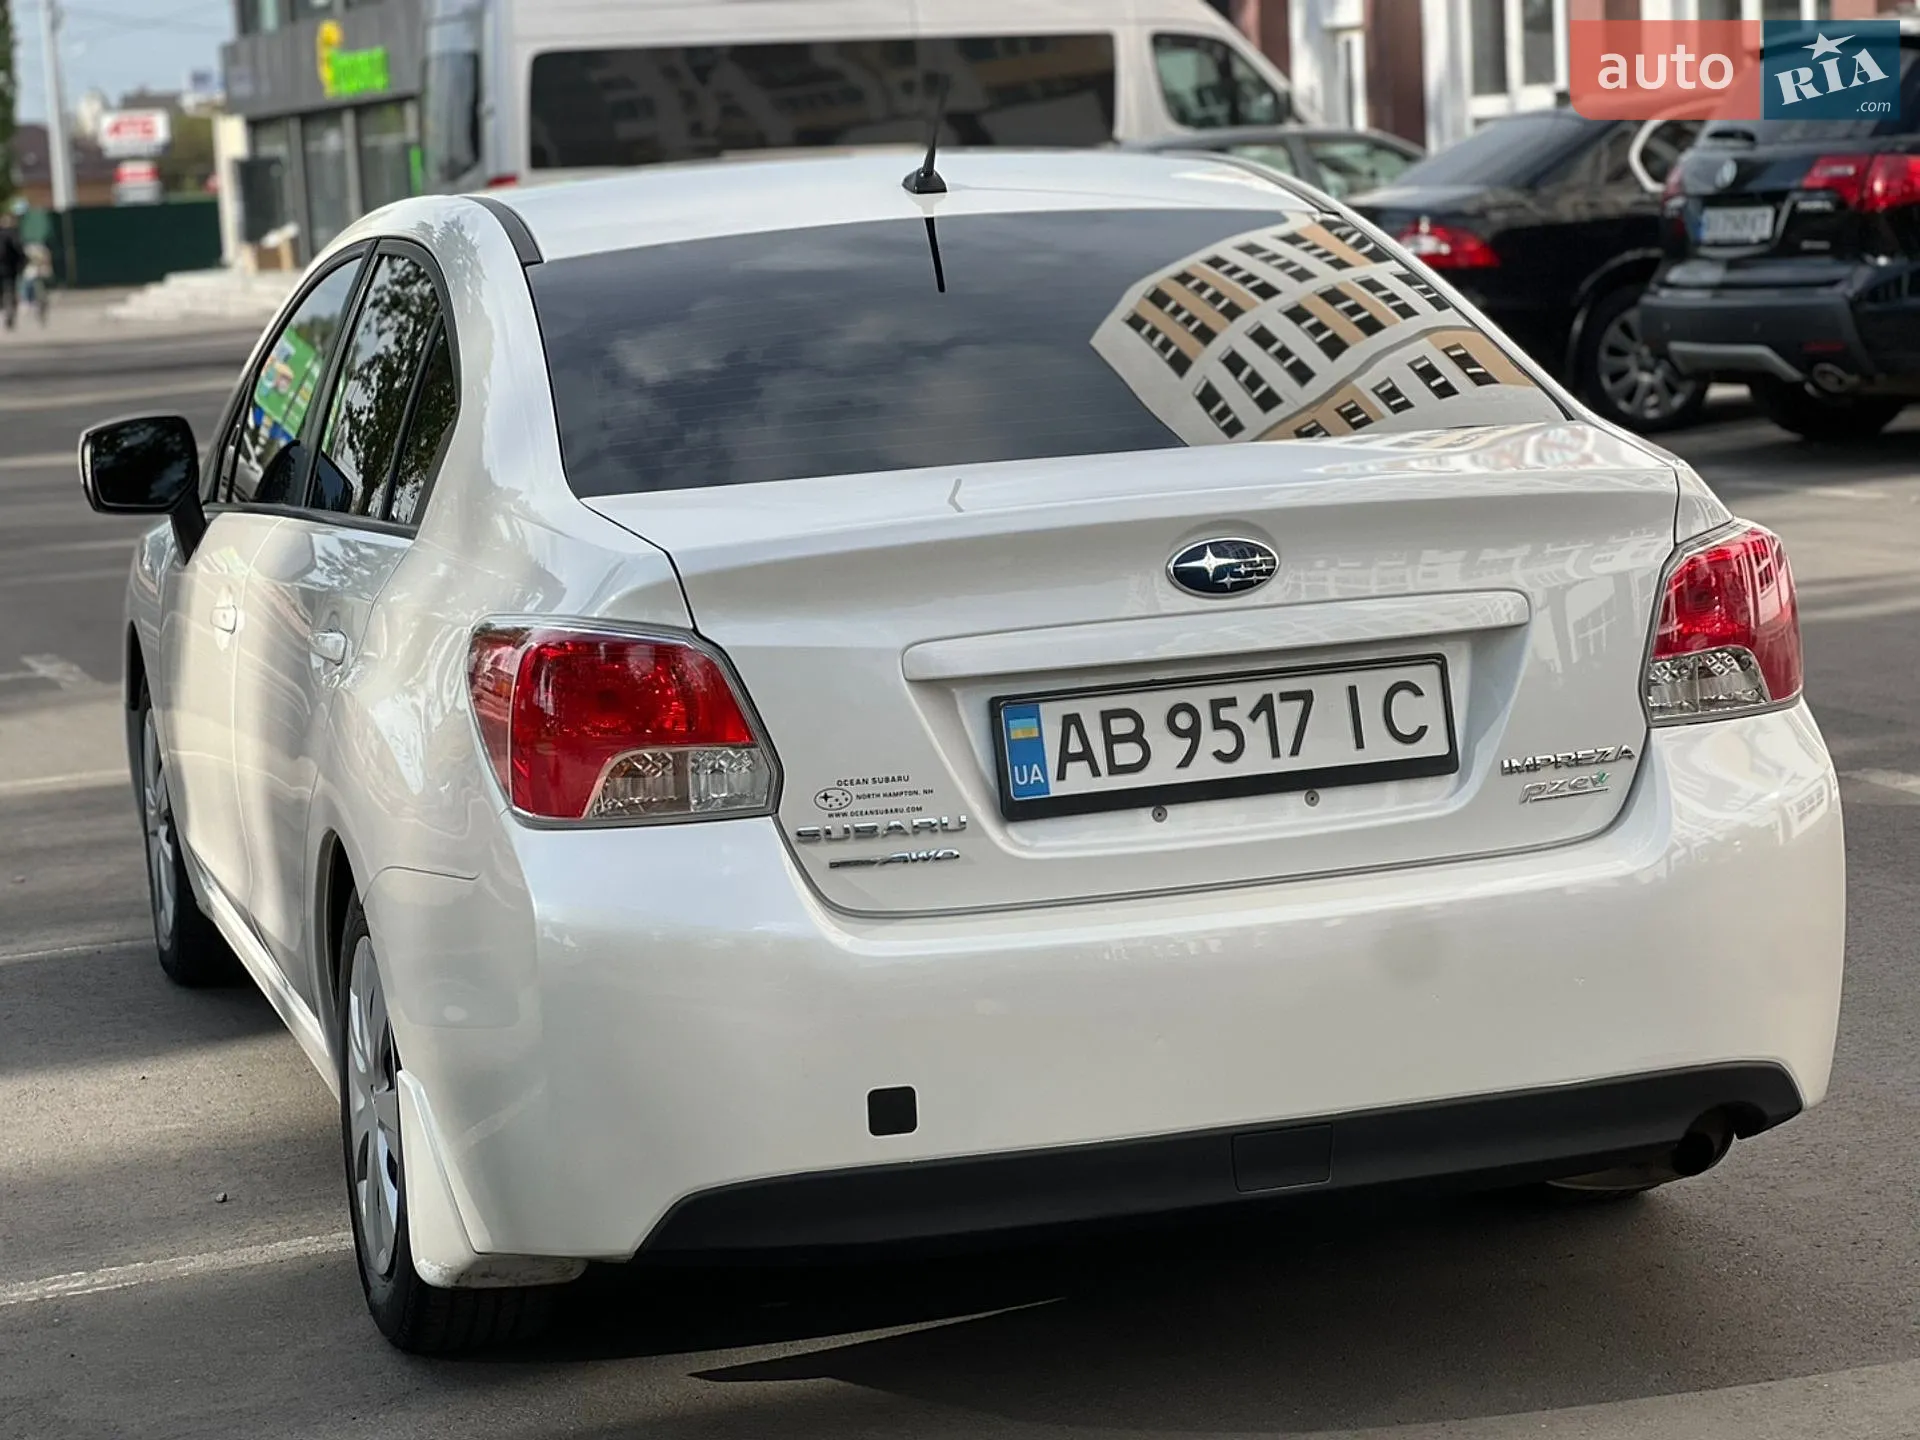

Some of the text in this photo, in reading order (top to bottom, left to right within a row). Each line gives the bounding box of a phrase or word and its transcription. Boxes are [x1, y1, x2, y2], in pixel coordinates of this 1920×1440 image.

[1055, 680, 1429, 782] AB 9517 IC
[1500, 744, 1636, 776] IMPREZA
[836, 774, 910, 787] OCEAN SUBARU
[1014, 764, 1046, 787] UA
[855, 792, 881, 801] NORTH
[922, 788, 934, 796] NH
[827, 805, 923, 819] WWW.OCEANSUBARU.COM
[795, 814, 967, 844] SUBARU
[882, 848, 961, 865] AWD
